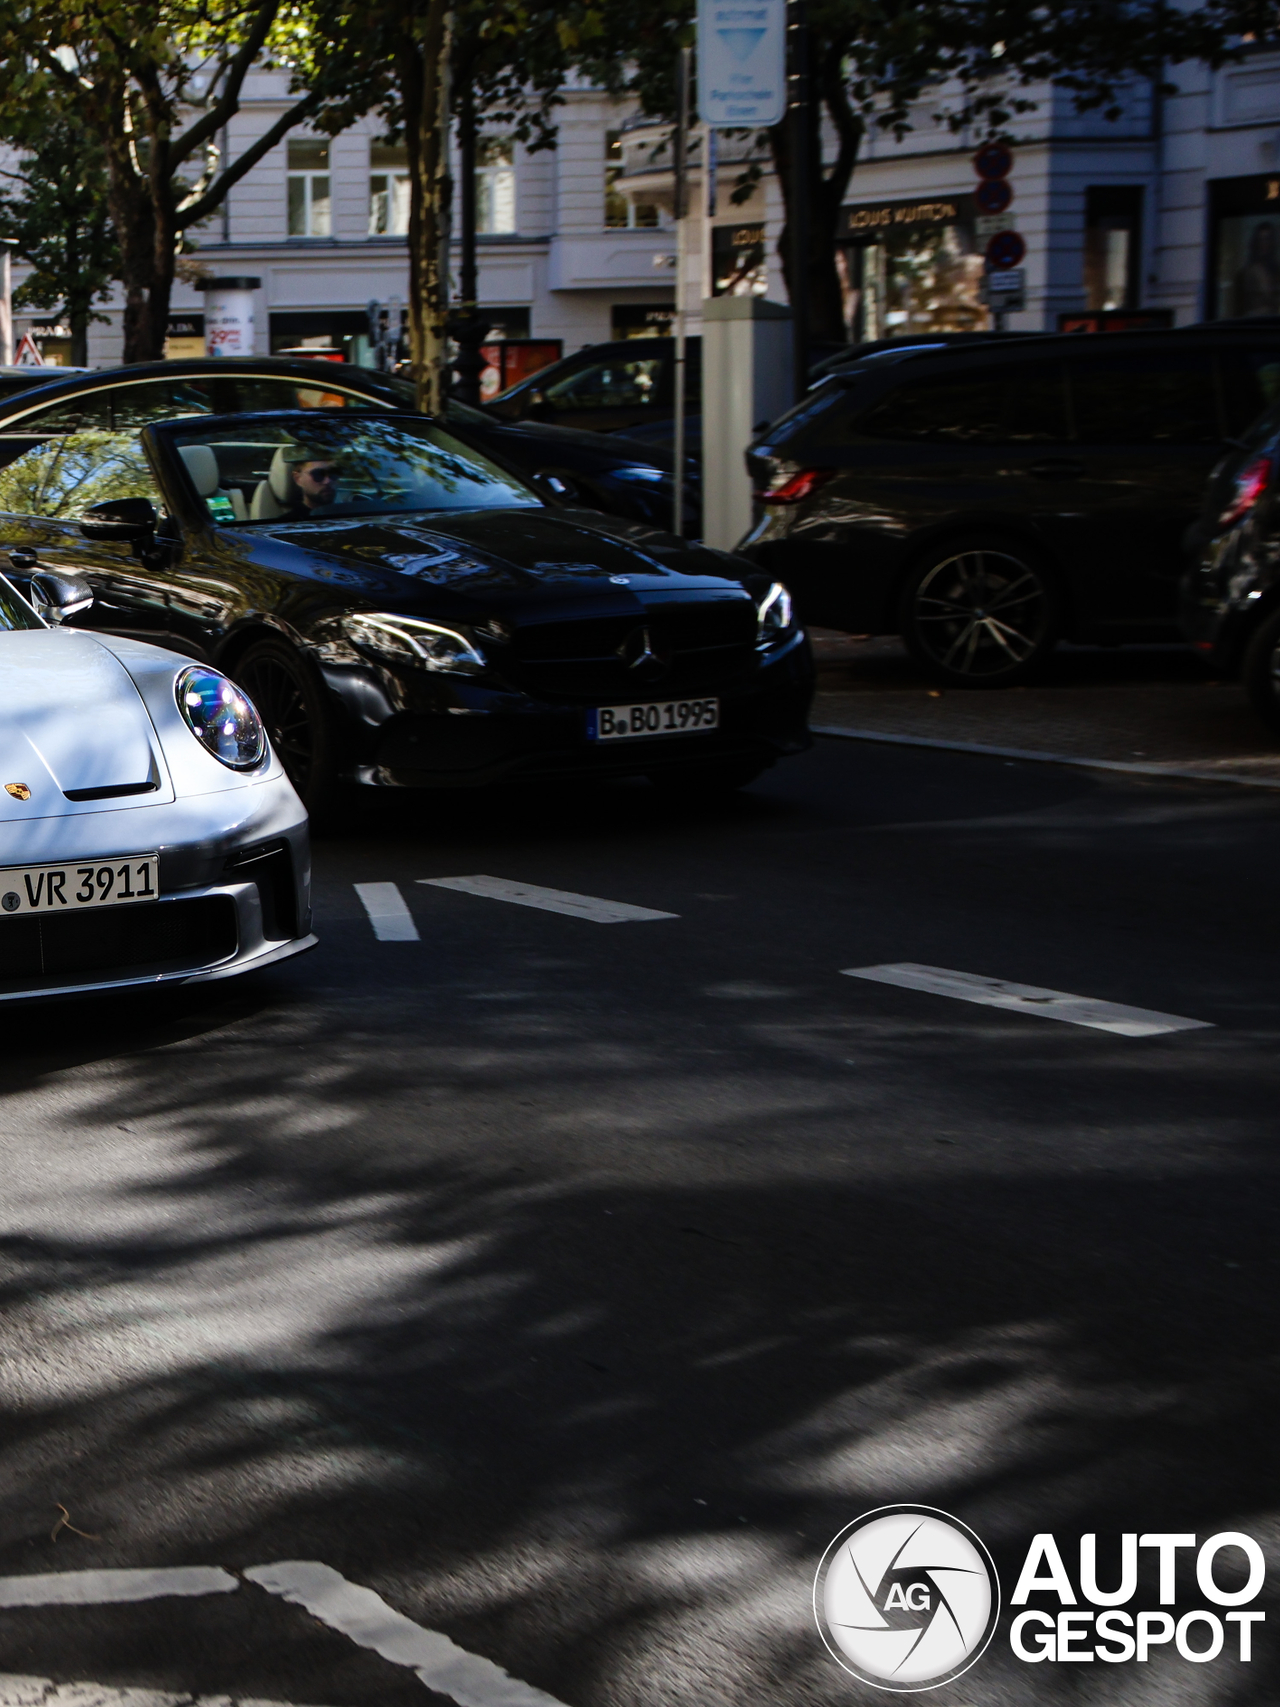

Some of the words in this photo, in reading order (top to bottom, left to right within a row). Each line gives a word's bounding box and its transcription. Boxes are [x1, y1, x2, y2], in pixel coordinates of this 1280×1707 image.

[848, 208, 891, 229] LOUIS
[600, 709, 615, 735] B
[664, 700, 716, 729] 1995
[24, 871, 68, 907] VR
[76, 862, 155, 902] 3911
